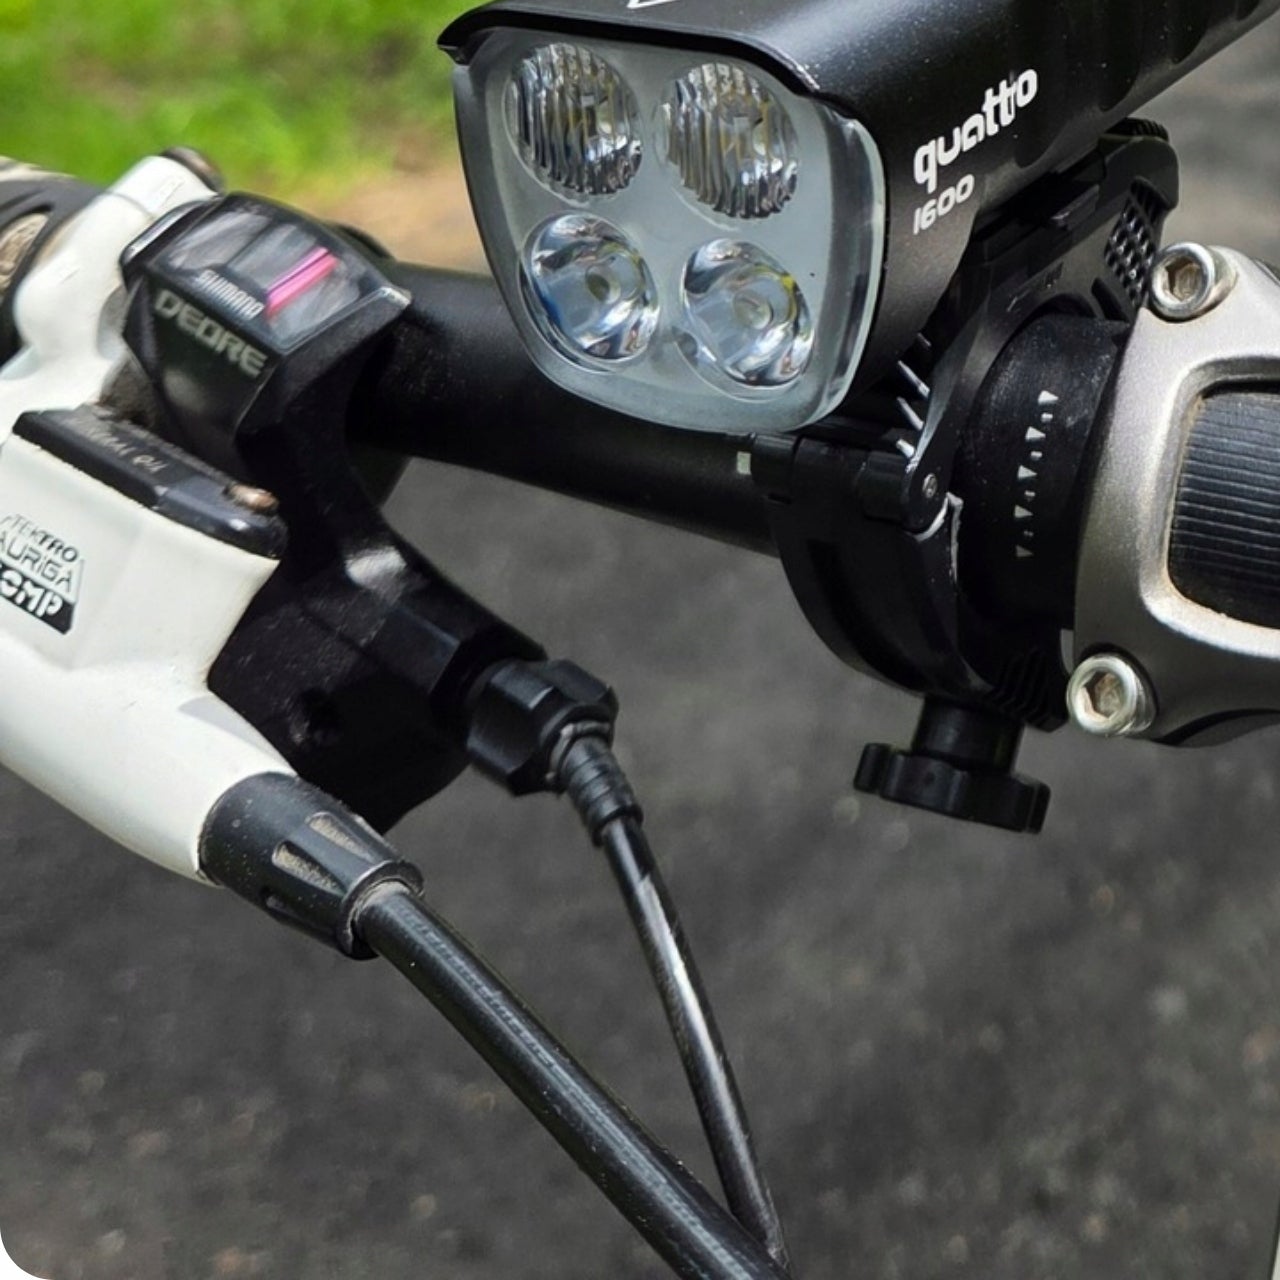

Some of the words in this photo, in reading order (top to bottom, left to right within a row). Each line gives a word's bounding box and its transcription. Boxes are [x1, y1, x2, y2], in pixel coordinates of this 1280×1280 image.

[912, 173, 976, 235] 1600
[154, 288, 268, 378] DEORE
[10, 513, 79, 563] TEKTRO
[0, 565, 64, 618] OMP
